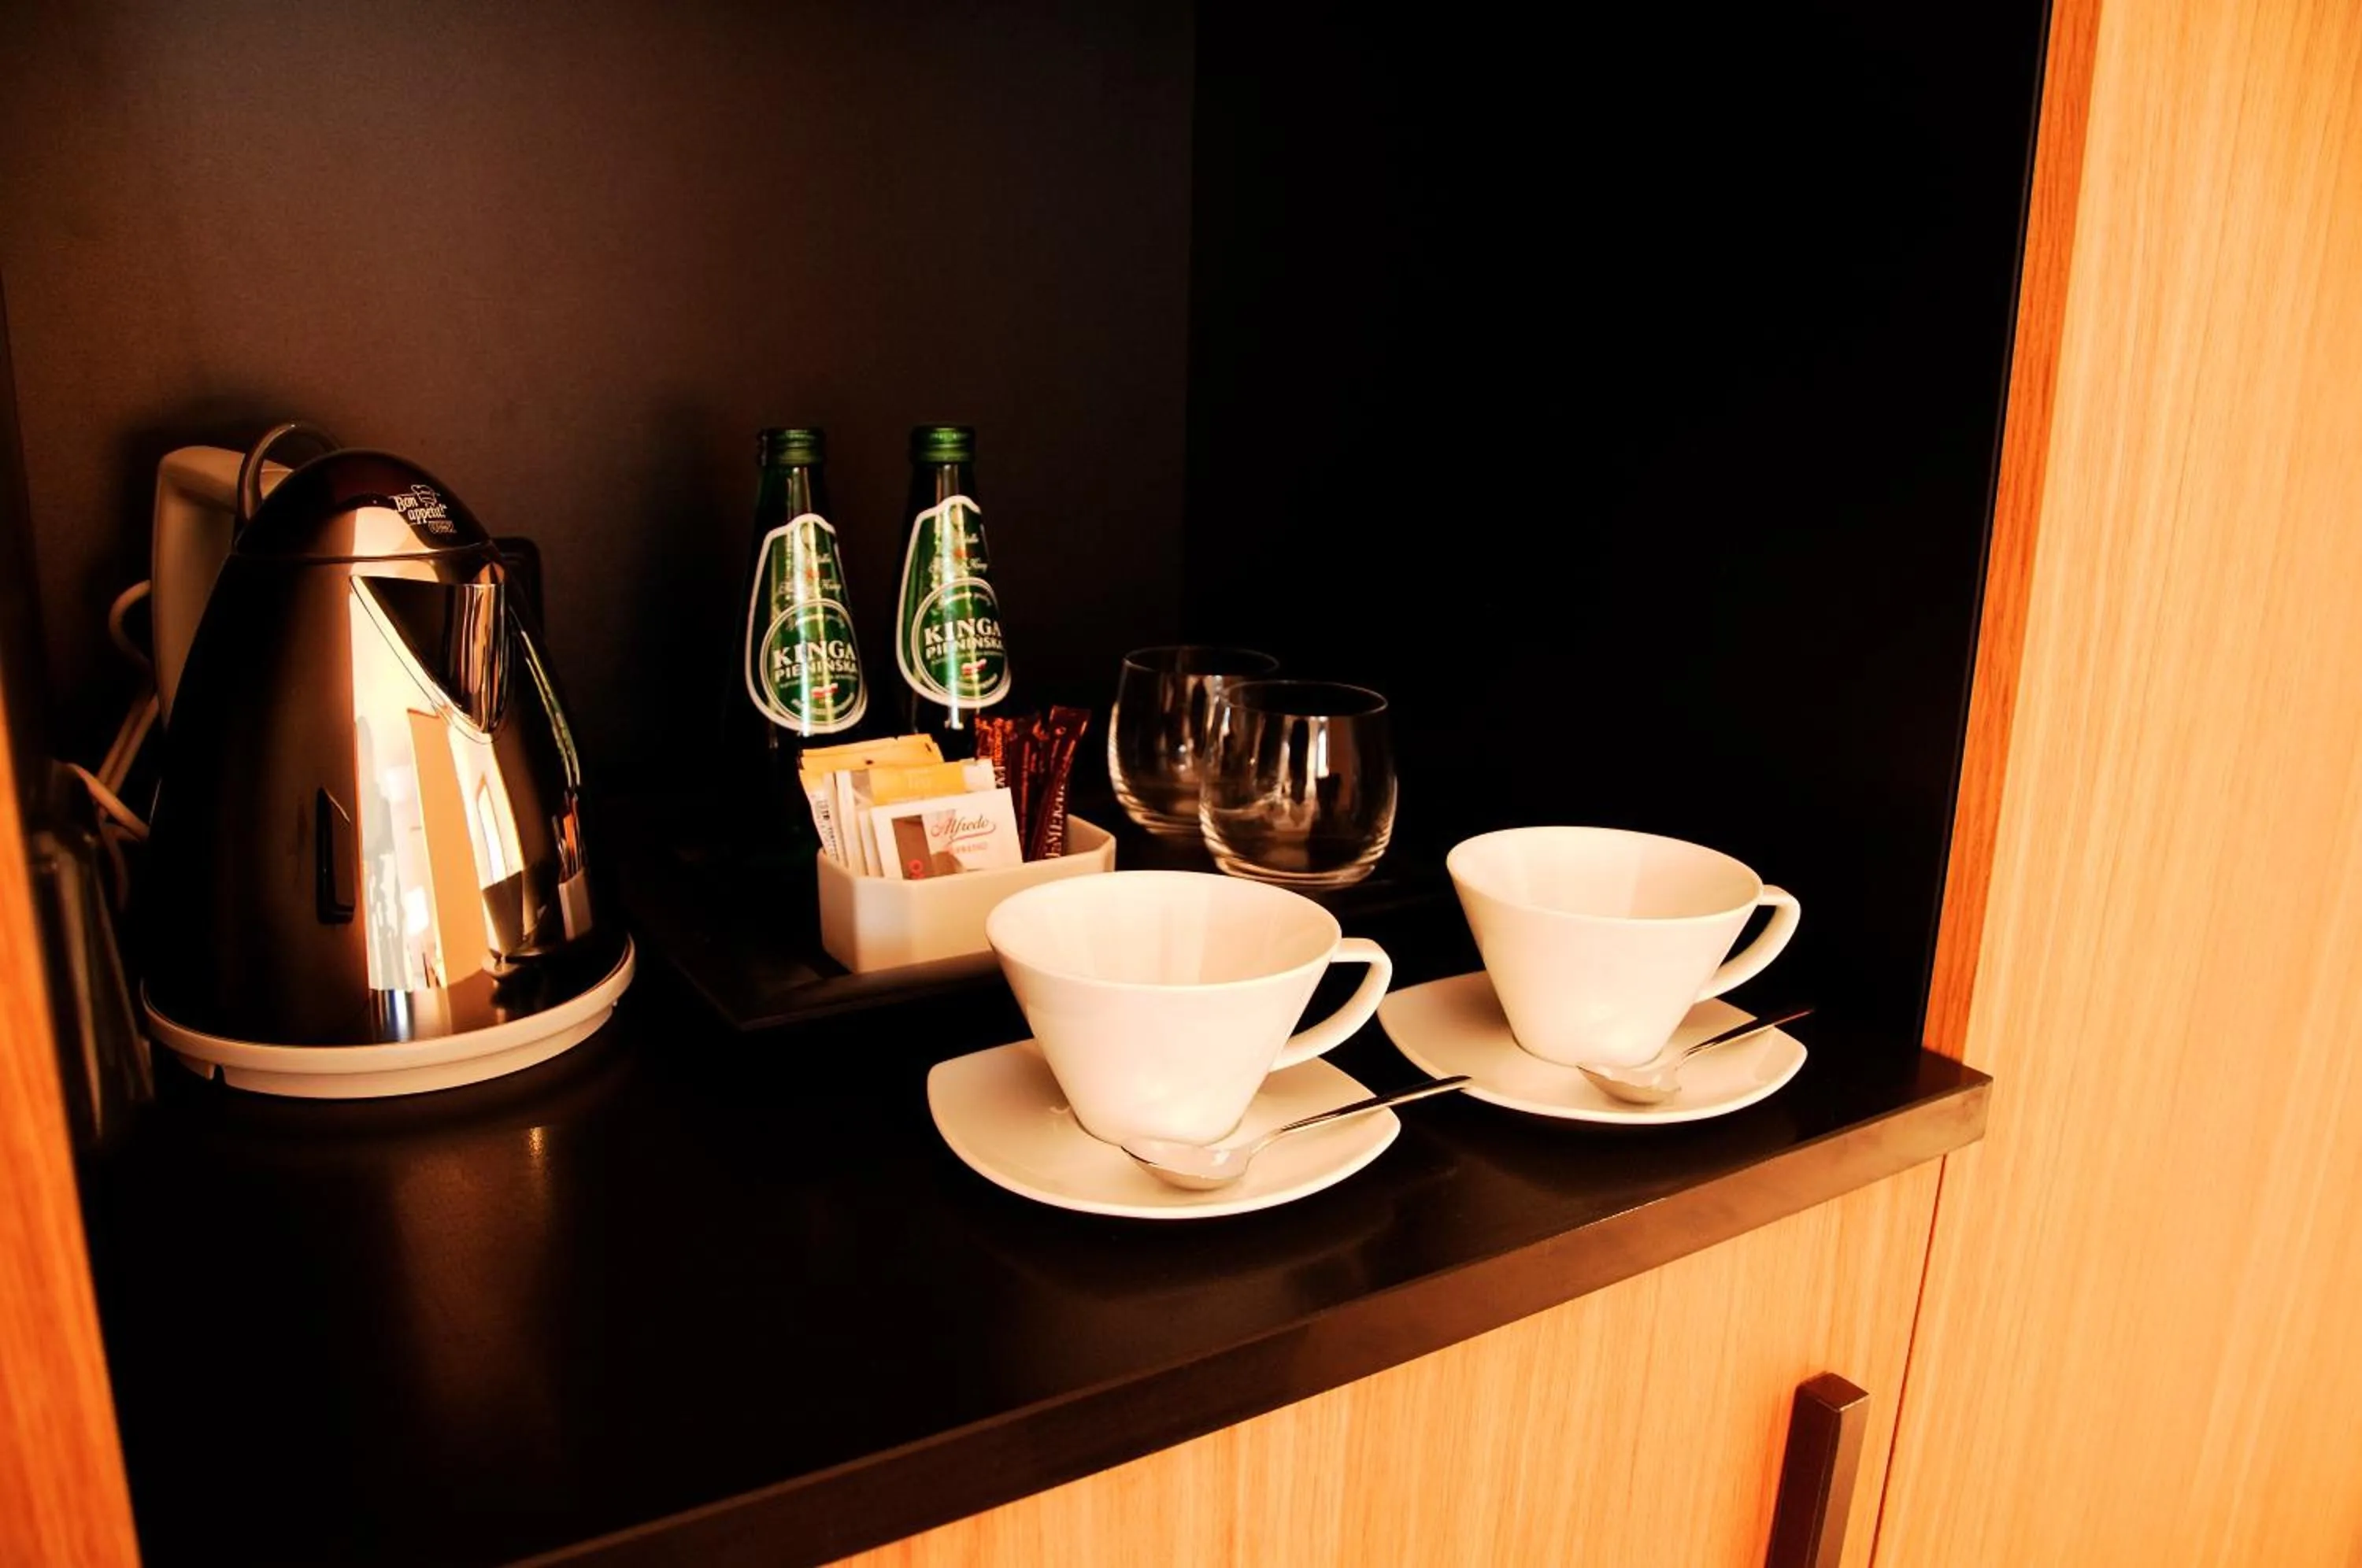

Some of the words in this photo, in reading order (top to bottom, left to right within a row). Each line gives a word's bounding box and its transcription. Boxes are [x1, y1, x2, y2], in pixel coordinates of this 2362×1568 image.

[395, 496, 418, 513] Bon
[924, 616, 1002, 645] KINGA
[772, 639, 856, 668] KINGA
[930, 813, 990, 841] Alfredo
